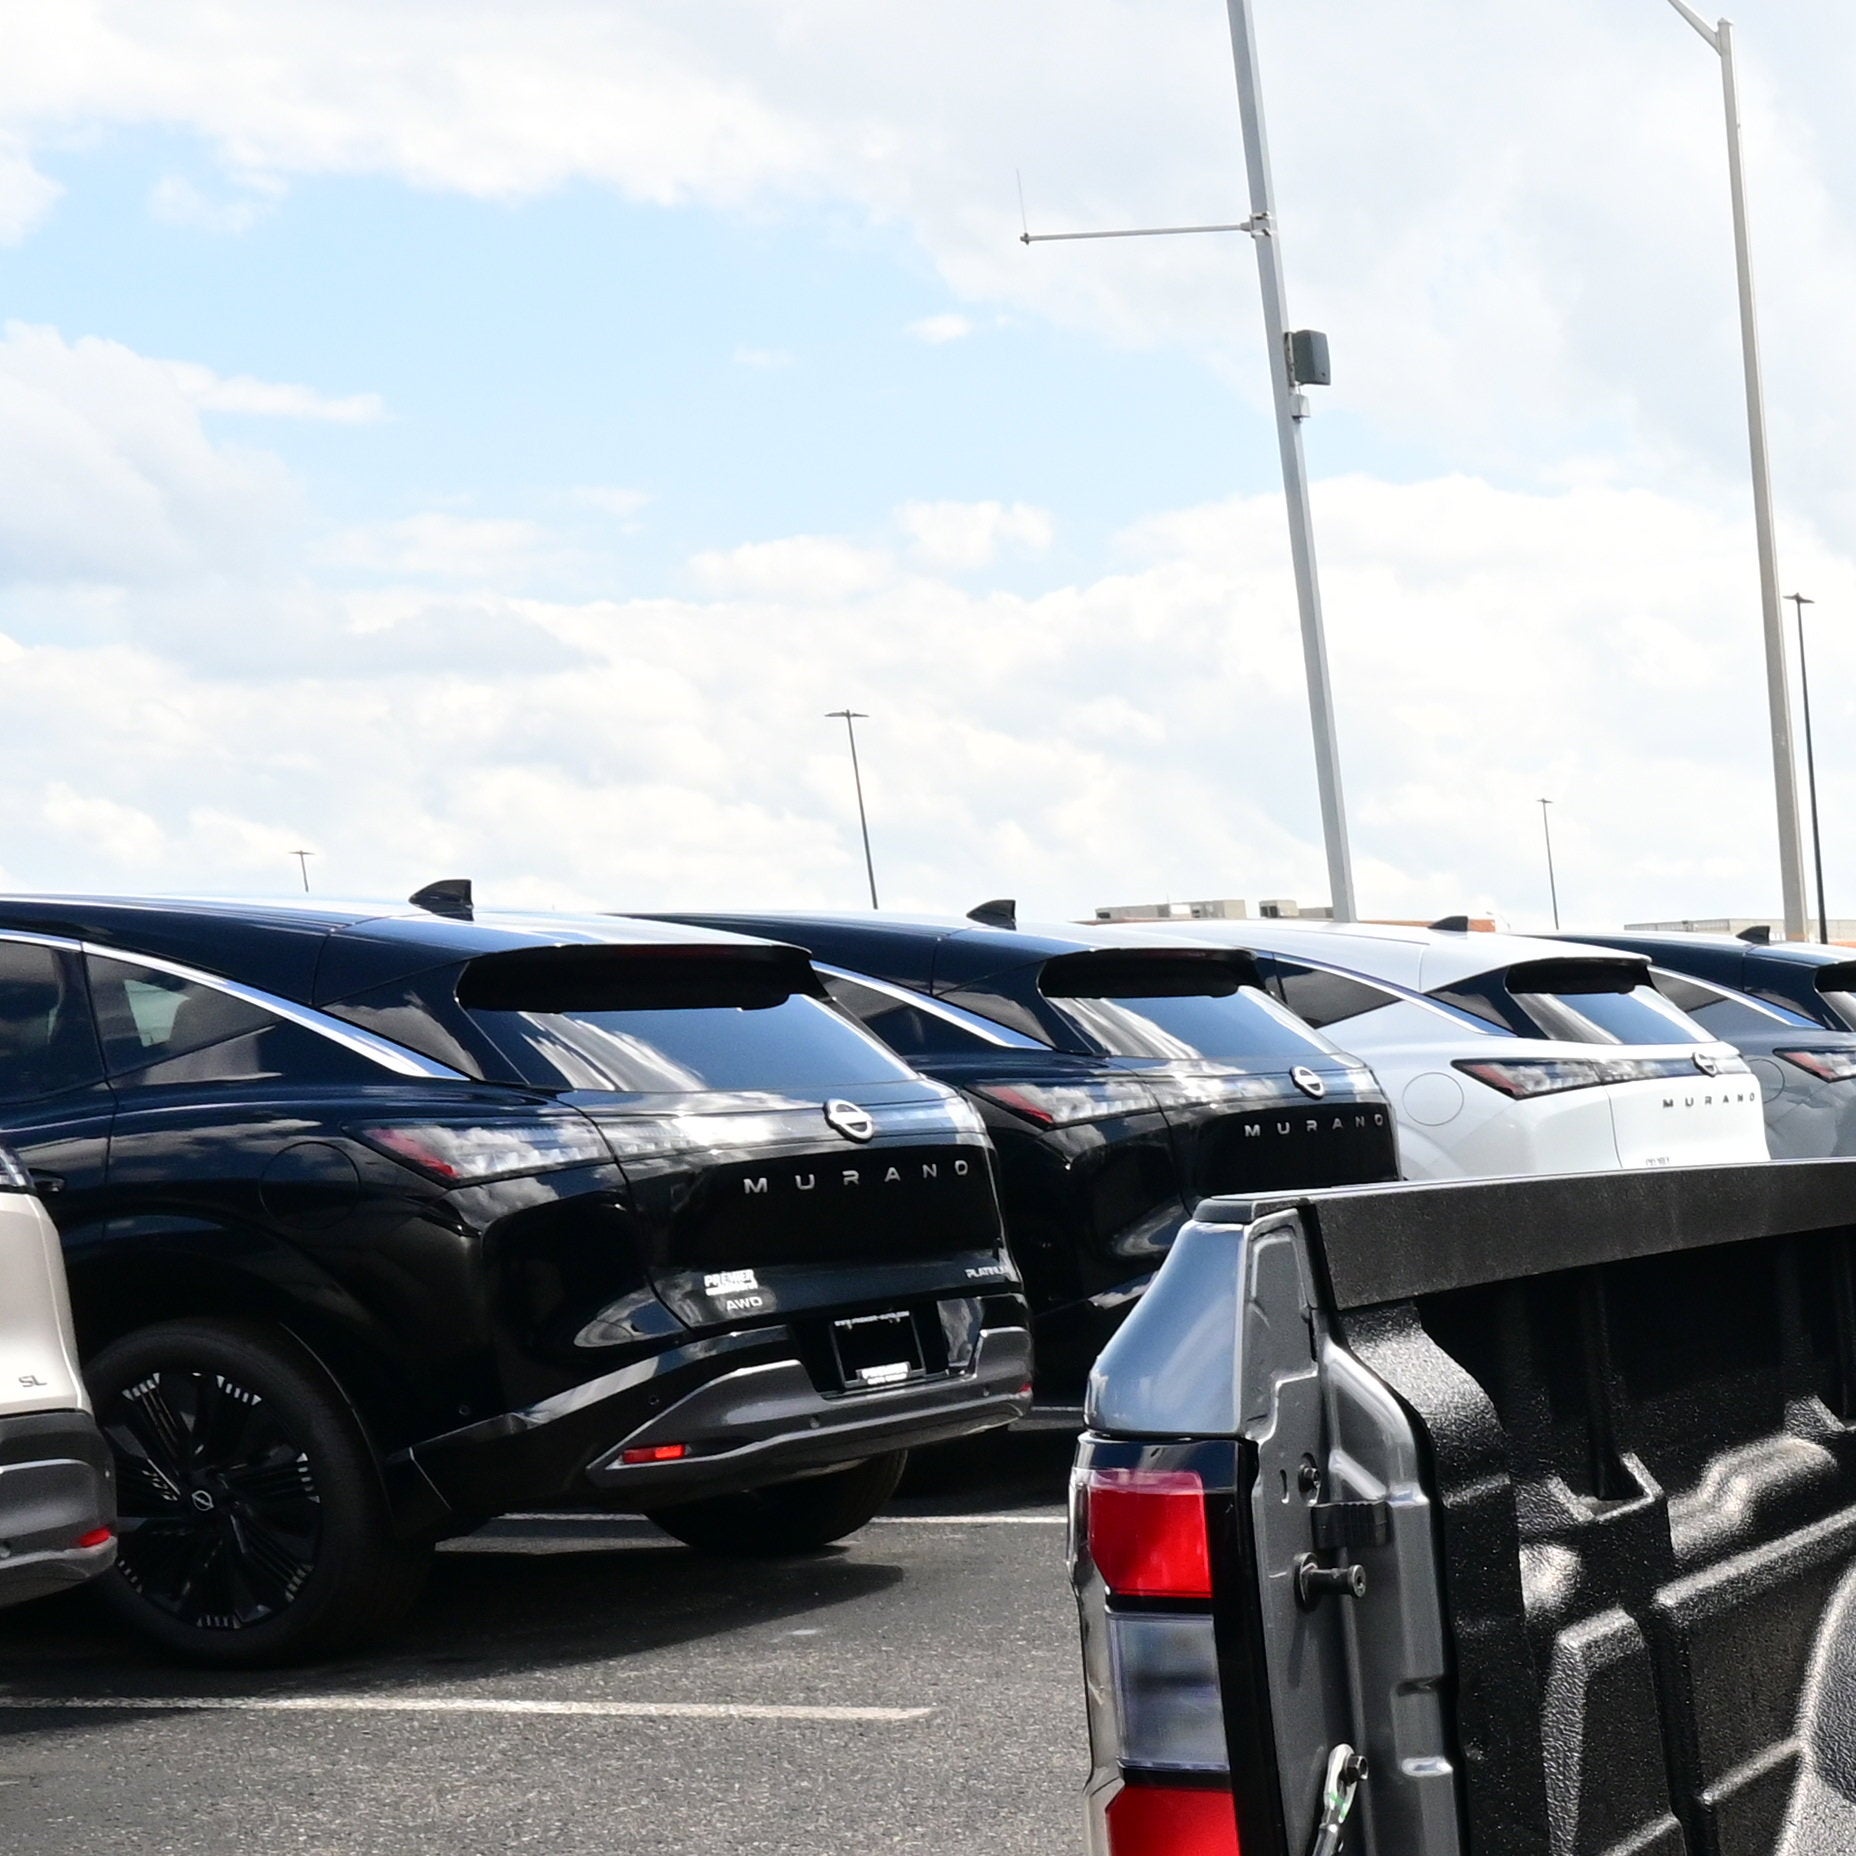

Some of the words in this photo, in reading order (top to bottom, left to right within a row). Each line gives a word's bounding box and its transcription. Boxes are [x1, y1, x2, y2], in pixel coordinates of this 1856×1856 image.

[1662, 1092, 1756, 1109] MURANO
[1244, 1113, 1384, 1137] MURANO
[743, 1160, 969, 1194] MURANO
[726, 1296, 763, 1312] AWD
[18, 1374, 48, 1388] SL
